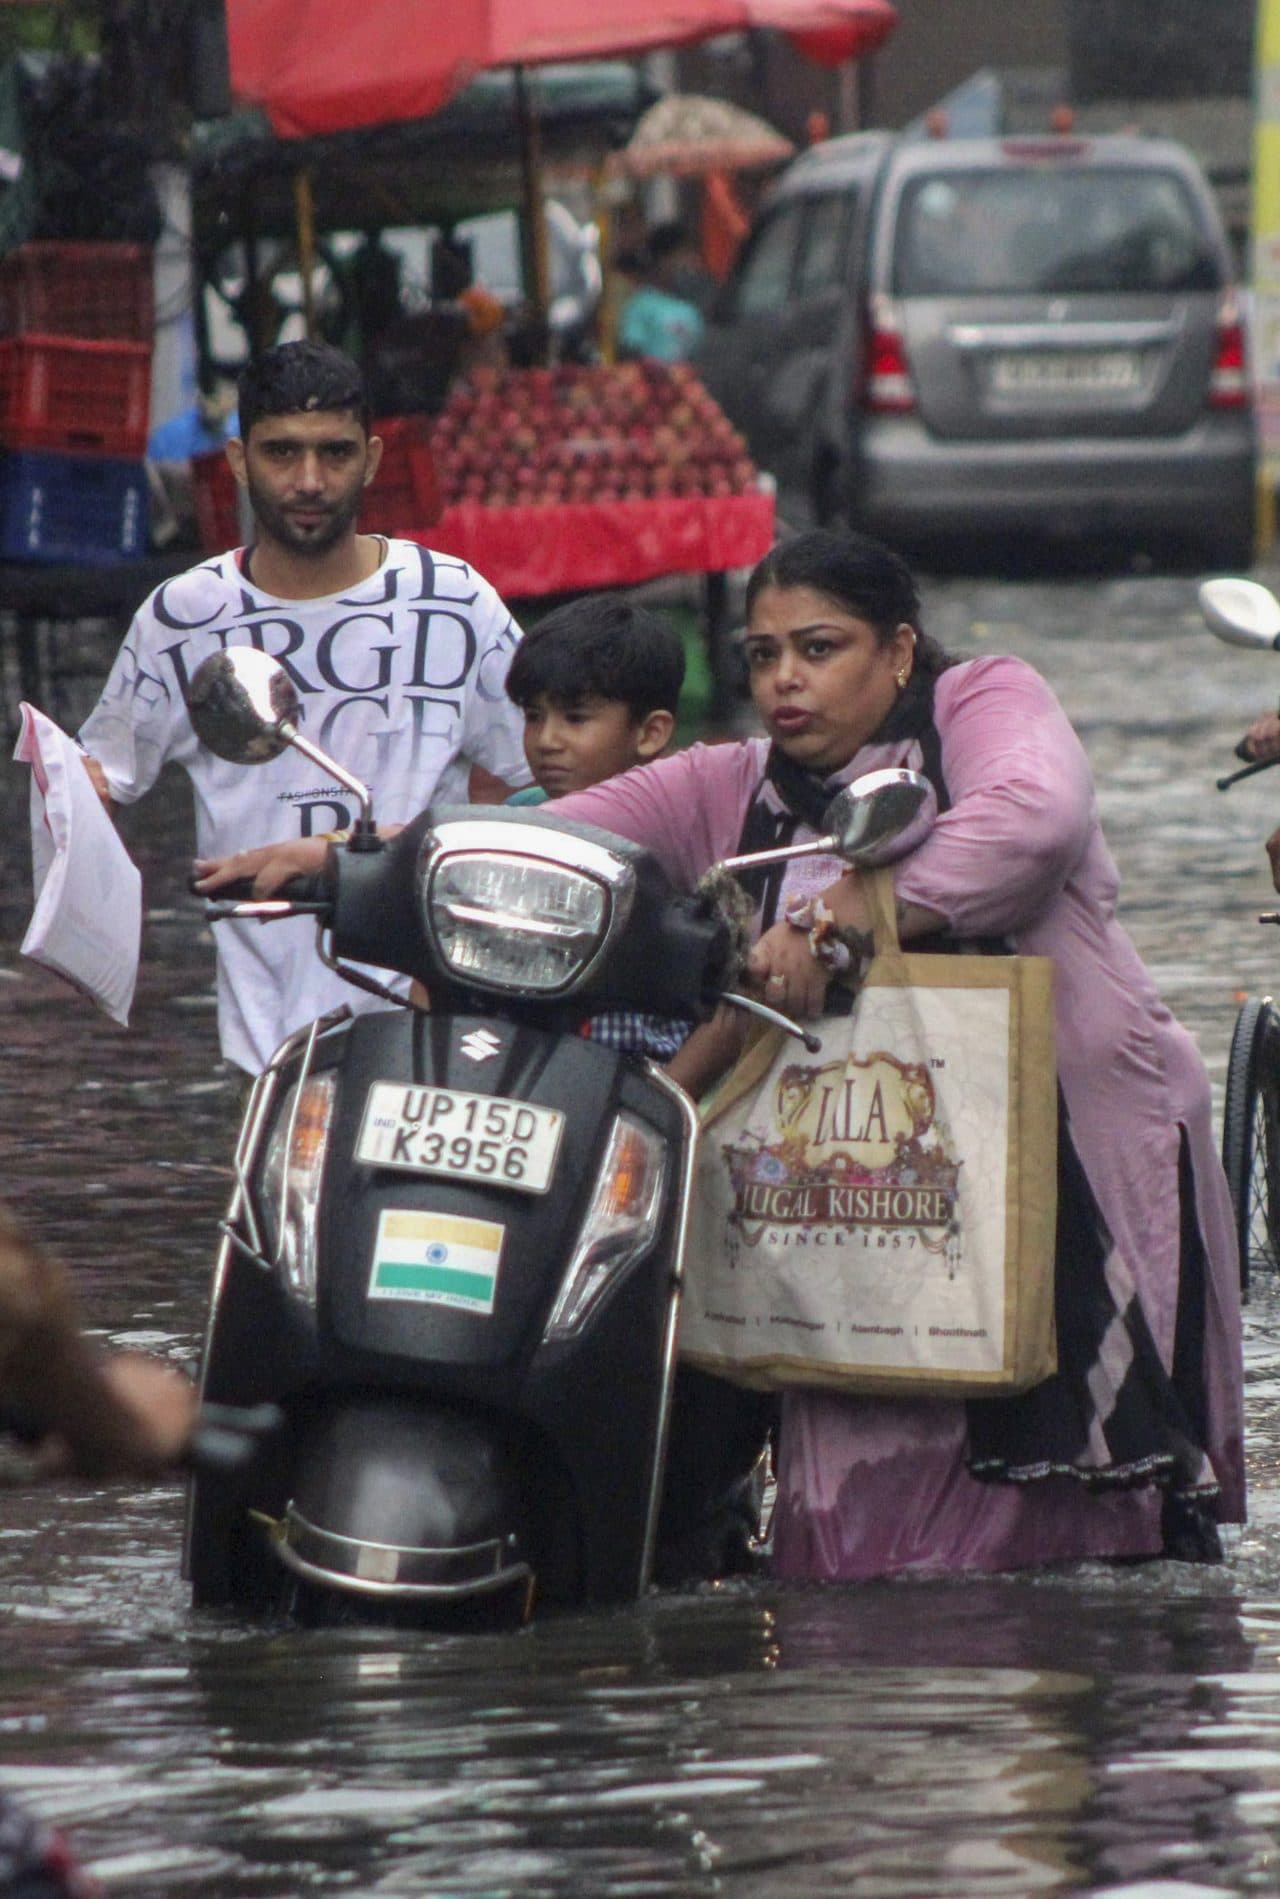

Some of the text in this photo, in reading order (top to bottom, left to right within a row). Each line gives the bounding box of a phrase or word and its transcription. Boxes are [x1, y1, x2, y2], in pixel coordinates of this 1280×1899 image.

[931, 1058, 945, 1069] TM
[392, 1127, 528, 1179] K3956
[742, 1184, 947, 1219] JUGAL KISHORE
[767, 1230, 916, 1249] SINCE 1857
